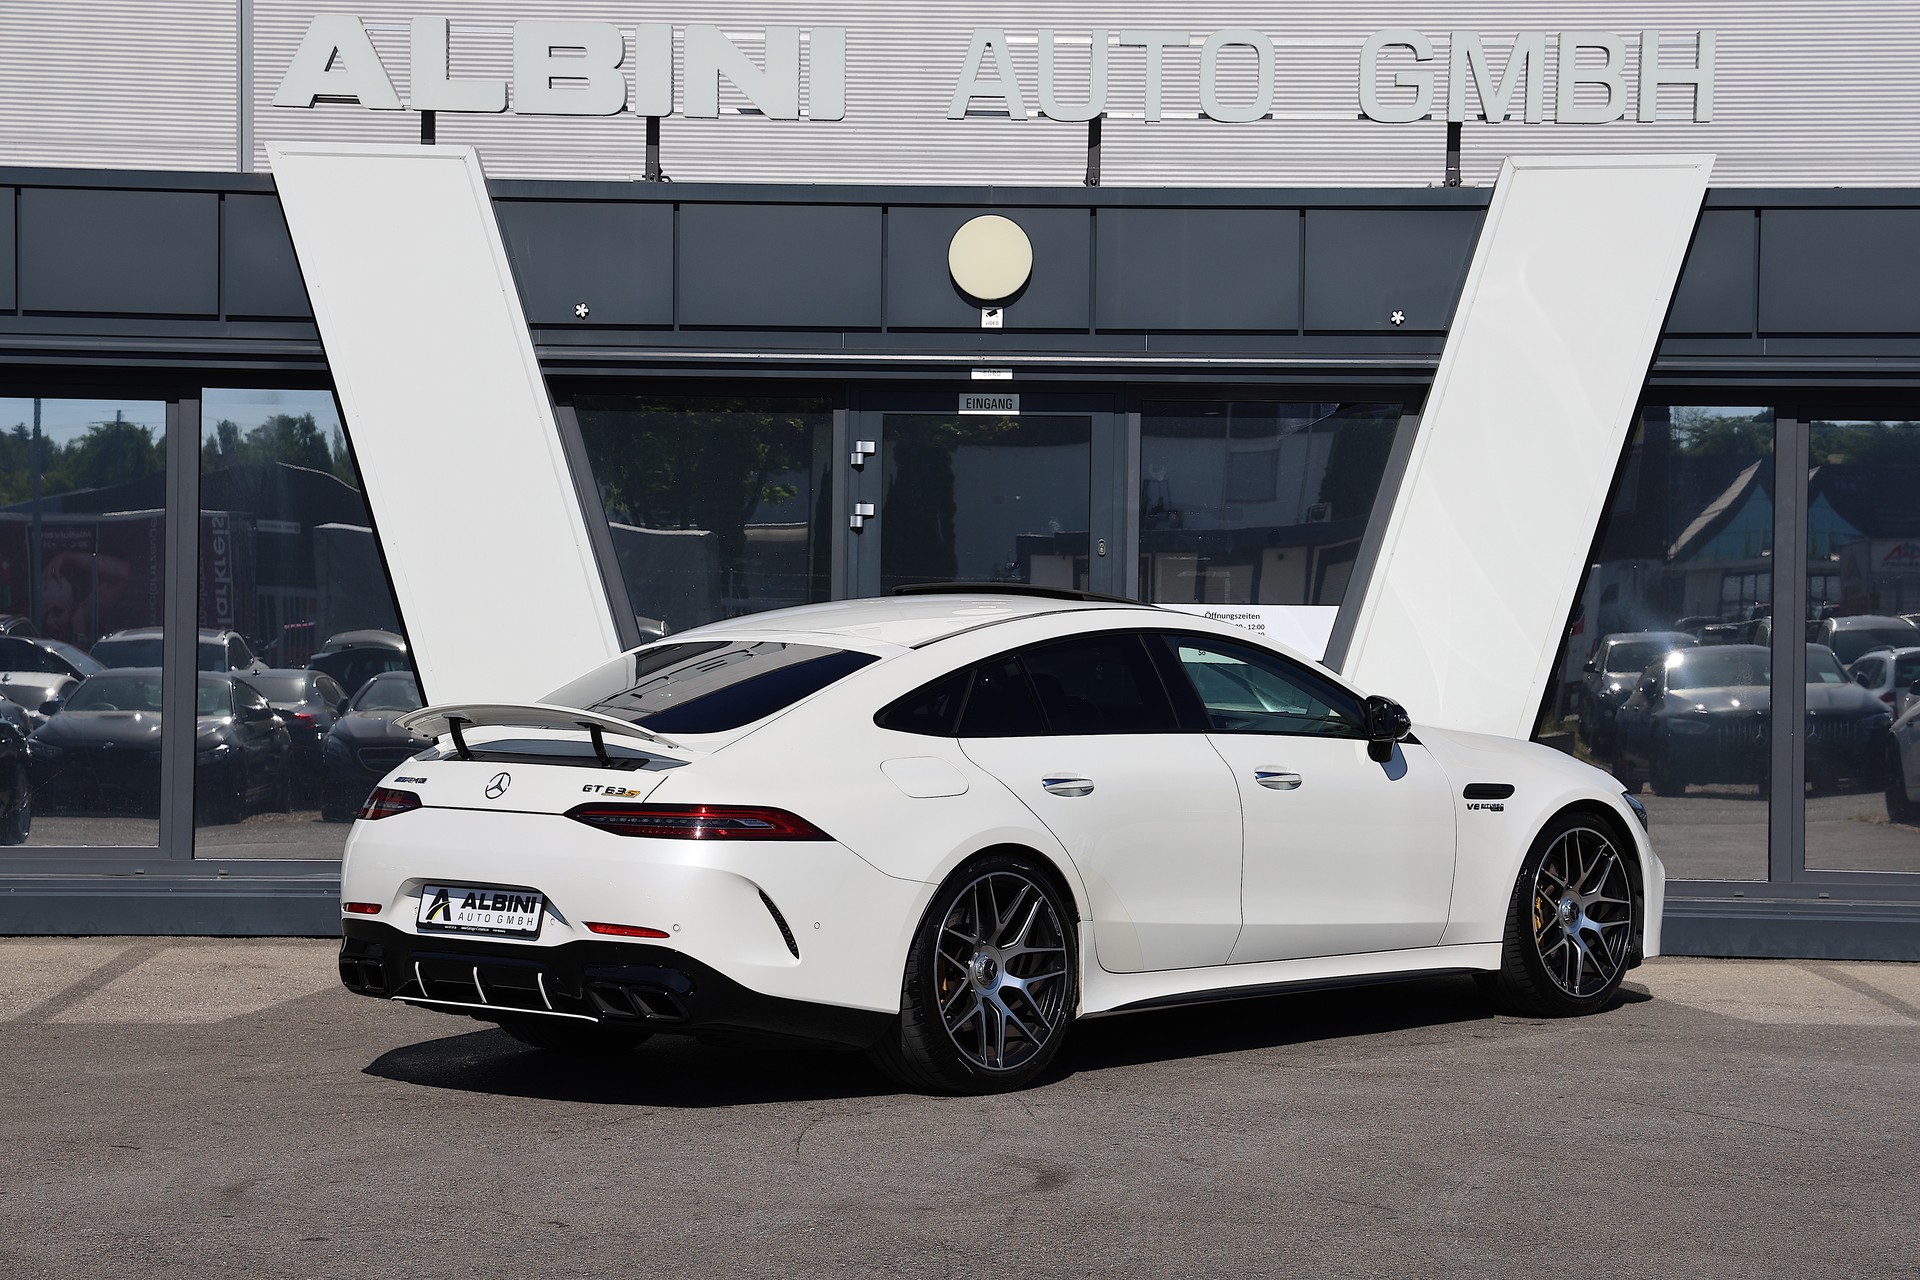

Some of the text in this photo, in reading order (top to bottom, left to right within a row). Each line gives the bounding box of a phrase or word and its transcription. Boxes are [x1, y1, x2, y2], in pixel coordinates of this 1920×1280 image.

[272, 14, 1718, 124] ALBINI AUTO GMBH
[966, 398, 1013, 410] EINGANG
[1204, 611, 1261, 620] Öffnungszeiten
[582, 784, 604, 793] GT
[460, 892, 538, 914] ALBINI
[458, 912, 534, 926] AUTO GMBH
